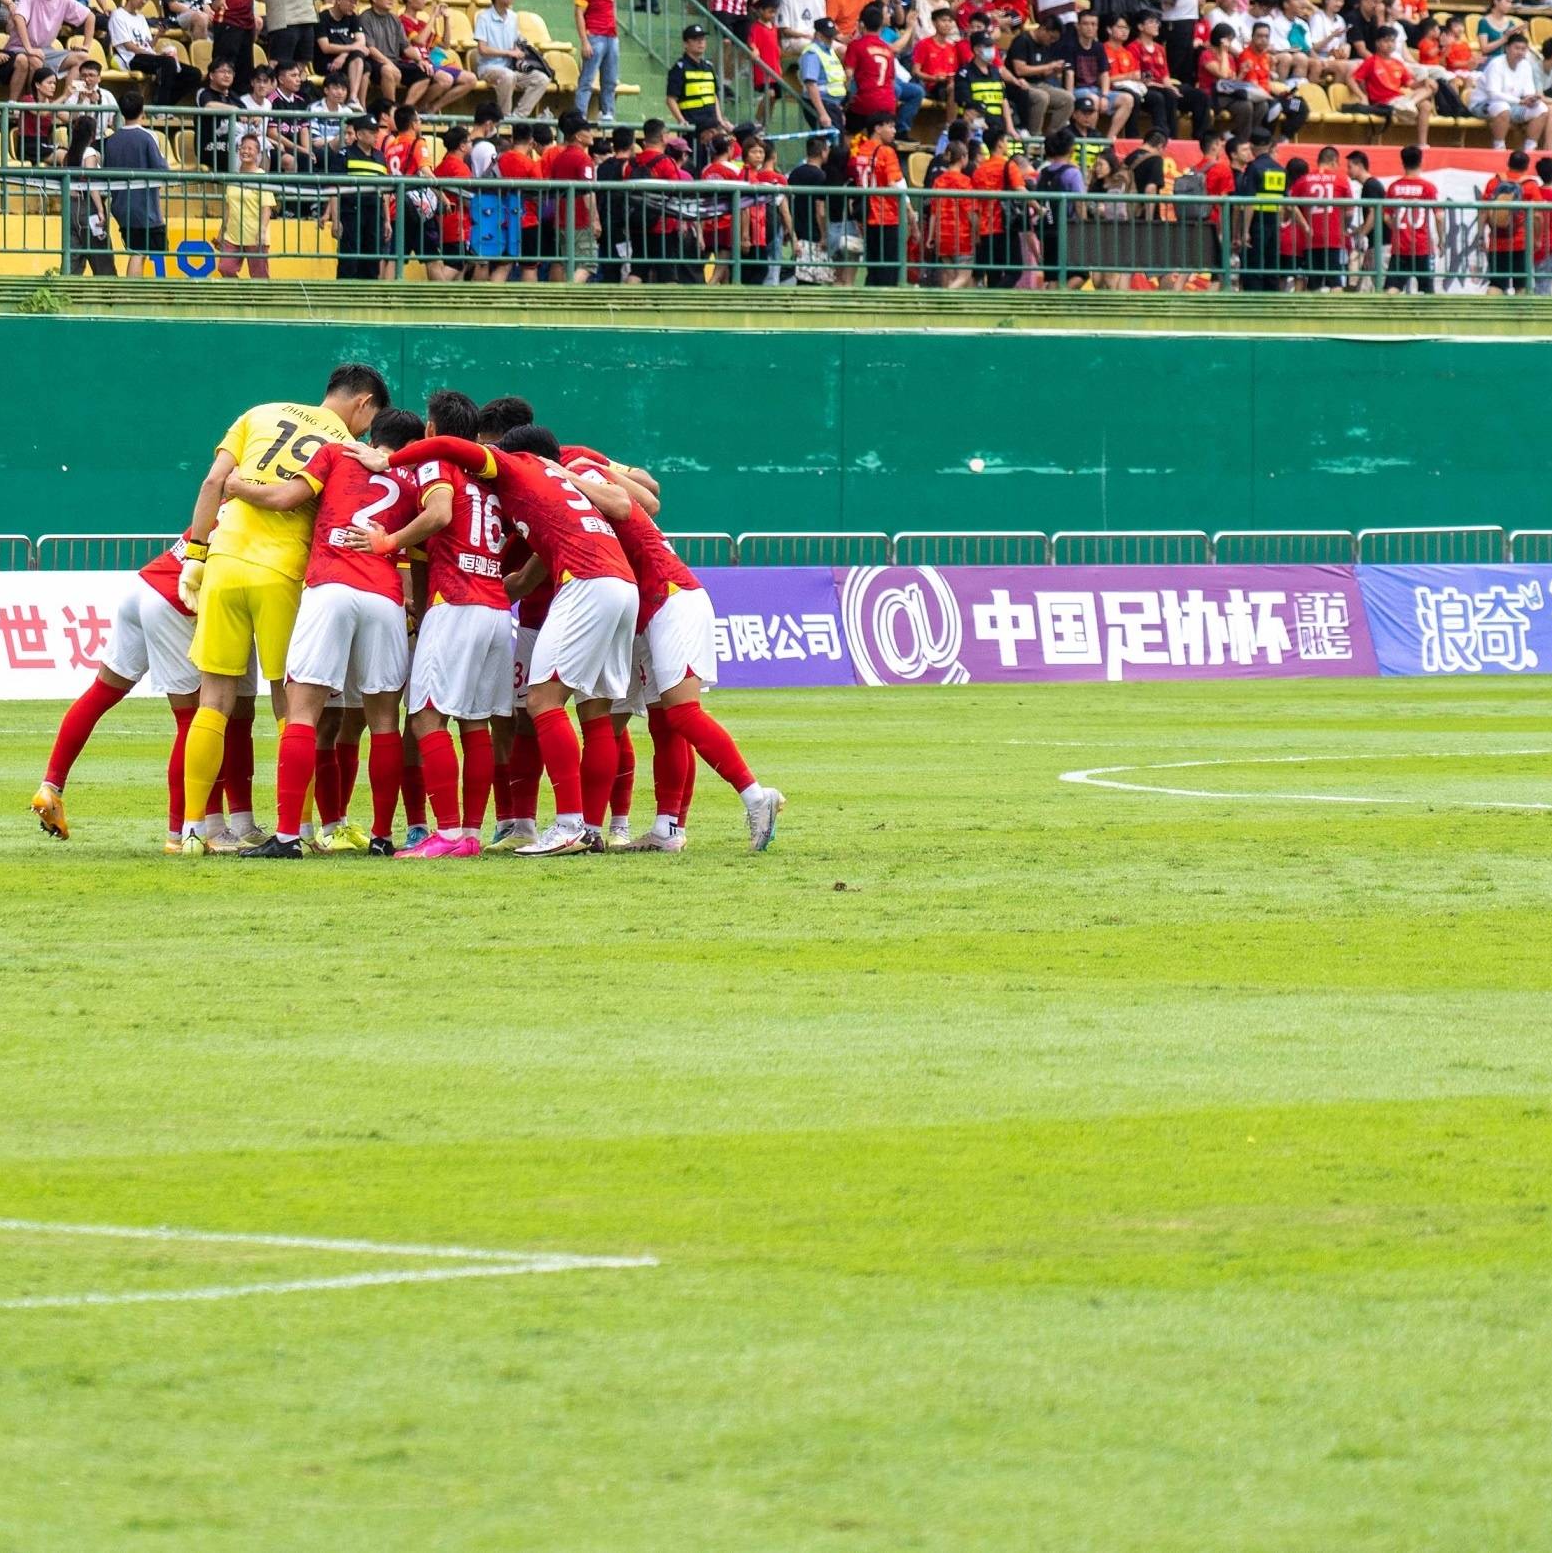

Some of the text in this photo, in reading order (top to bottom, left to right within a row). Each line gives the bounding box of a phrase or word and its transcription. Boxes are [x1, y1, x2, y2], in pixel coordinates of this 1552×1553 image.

[875, 57, 889, 85] 7
[1310, 182, 1335, 215] 21
[1396, 203, 1426, 230] 20
[281, 405, 319, 427] ZHANG
[256, 419, 330, 481] 19
[351, 474, 401, 531] 2
[465, 482, 509, 555] 16
[973, 589, 1292, 681] 中国足协杯
[1416, 585, 1538, 673] 浪奇
